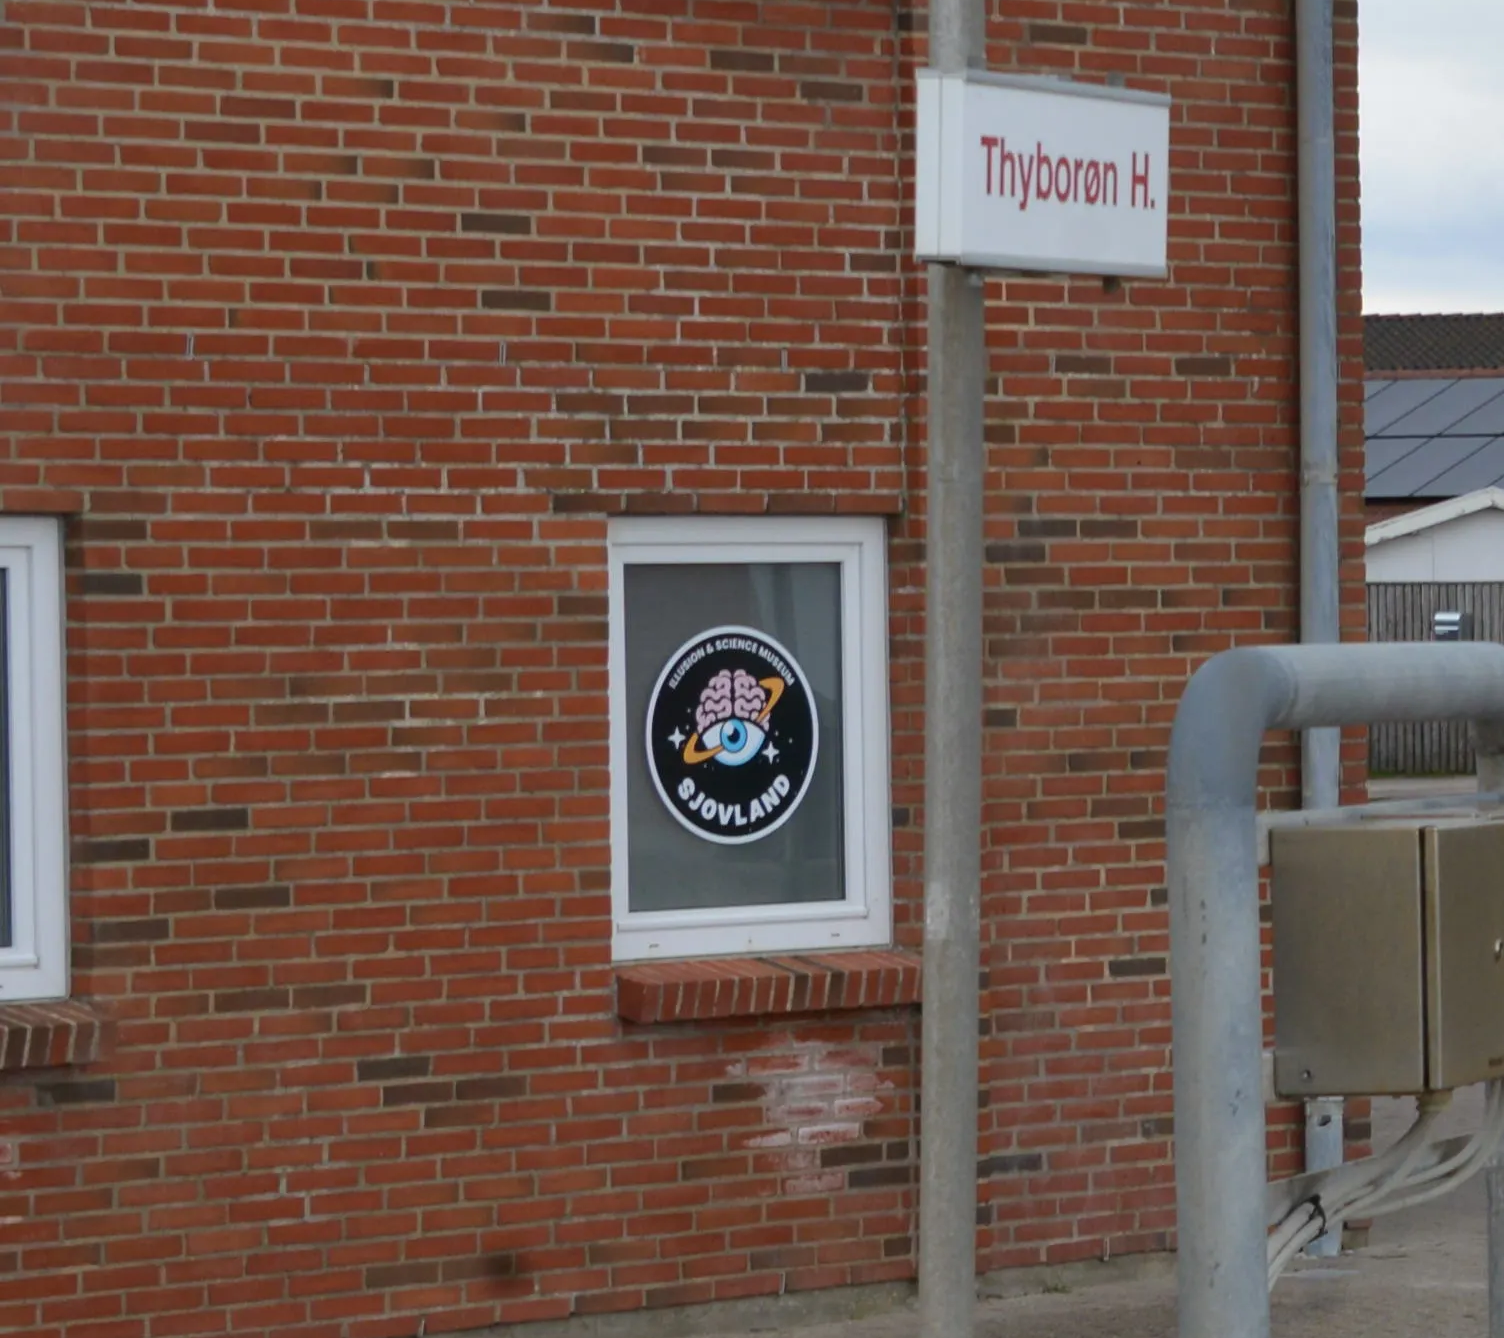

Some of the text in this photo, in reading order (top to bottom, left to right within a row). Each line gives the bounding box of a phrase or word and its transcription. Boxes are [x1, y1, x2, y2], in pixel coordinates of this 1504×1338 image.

[980, 135, 1156, 211] Thyborøn H.
[669, 637, 796, 689] ILLUSION & SCIENCE MUSEUM
[678, 774, 791, 826] SJOVLAND
